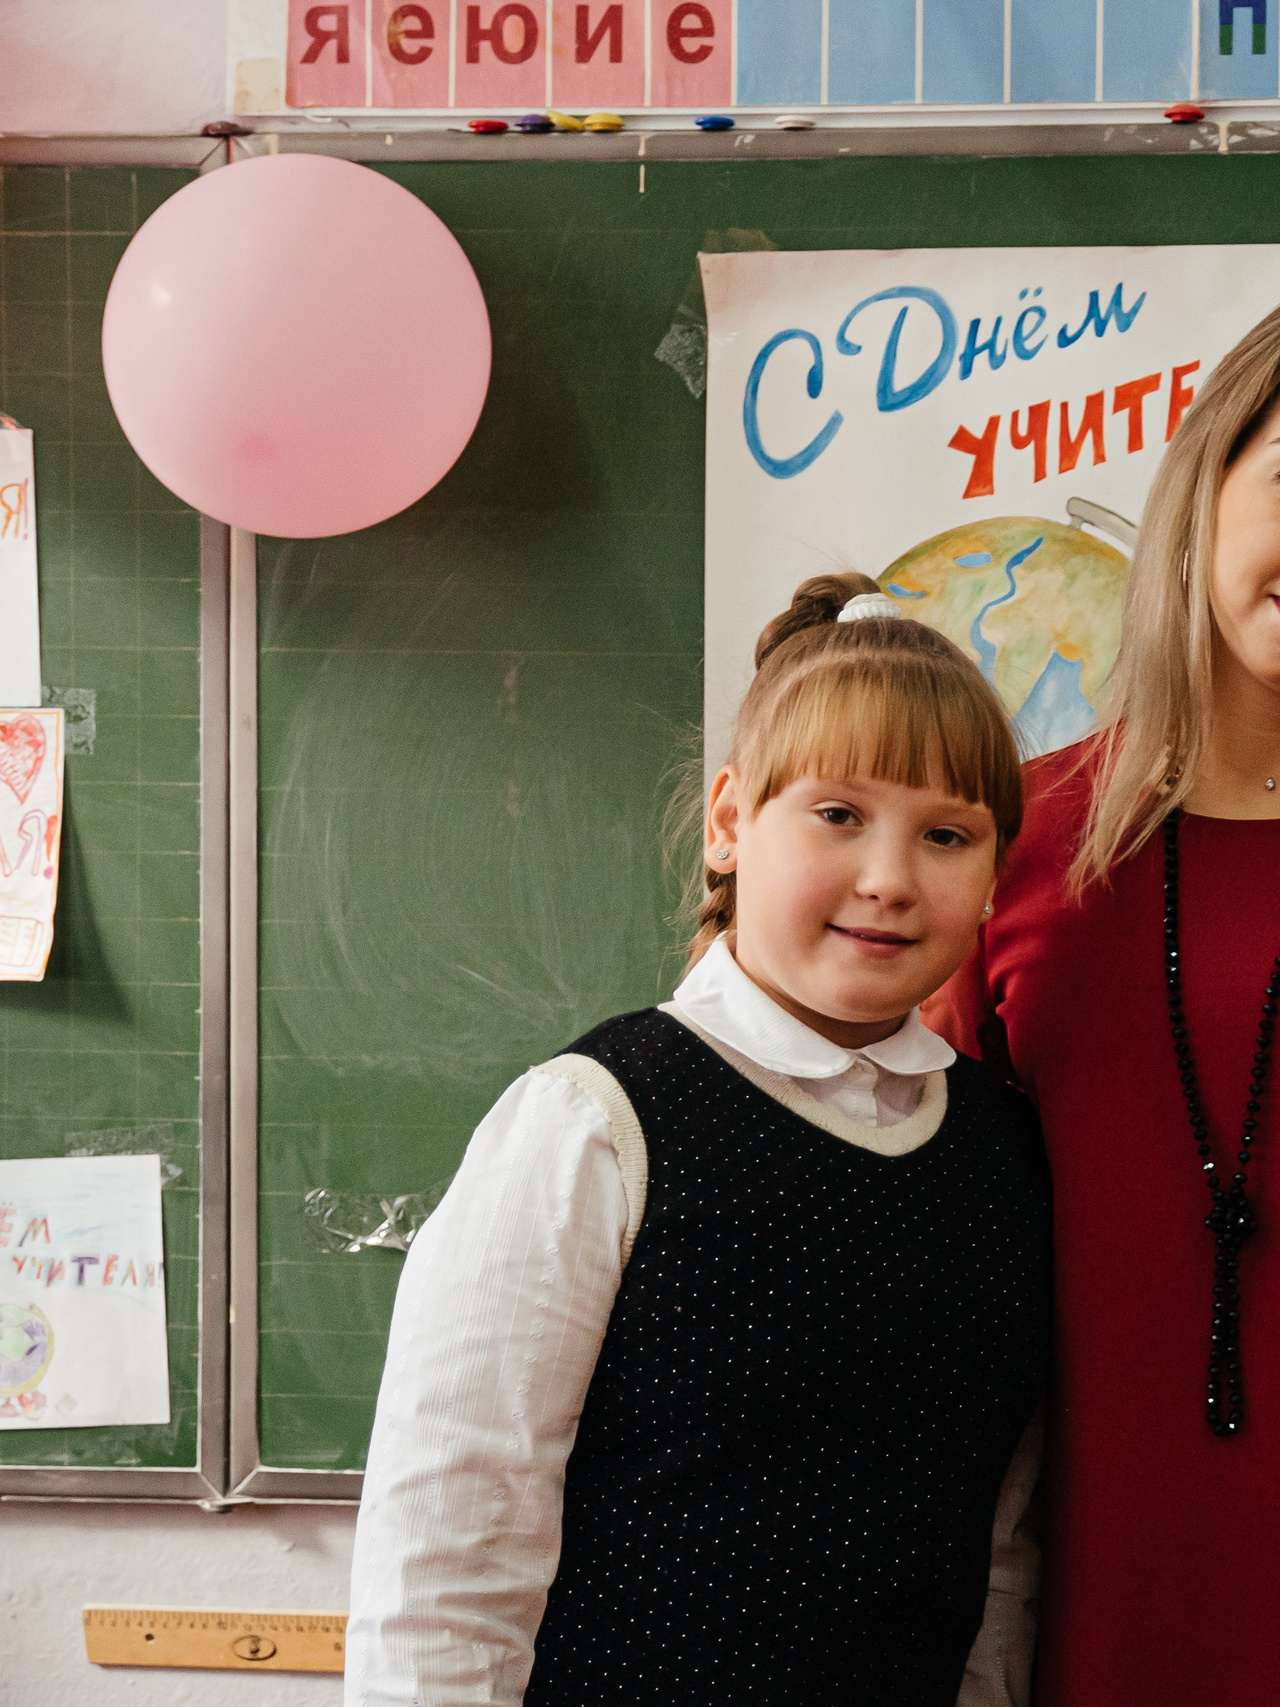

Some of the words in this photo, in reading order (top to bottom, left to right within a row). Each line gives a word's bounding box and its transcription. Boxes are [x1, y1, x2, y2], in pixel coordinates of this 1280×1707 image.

[300, 4, 350, 64] я
[465, 4, 539, 65] ю
[574, 4, 623, 64] и
[665, 1, 715, 65] е
[743, 328, 844, 479] С
[836, 281, 1147, 413] Днём
